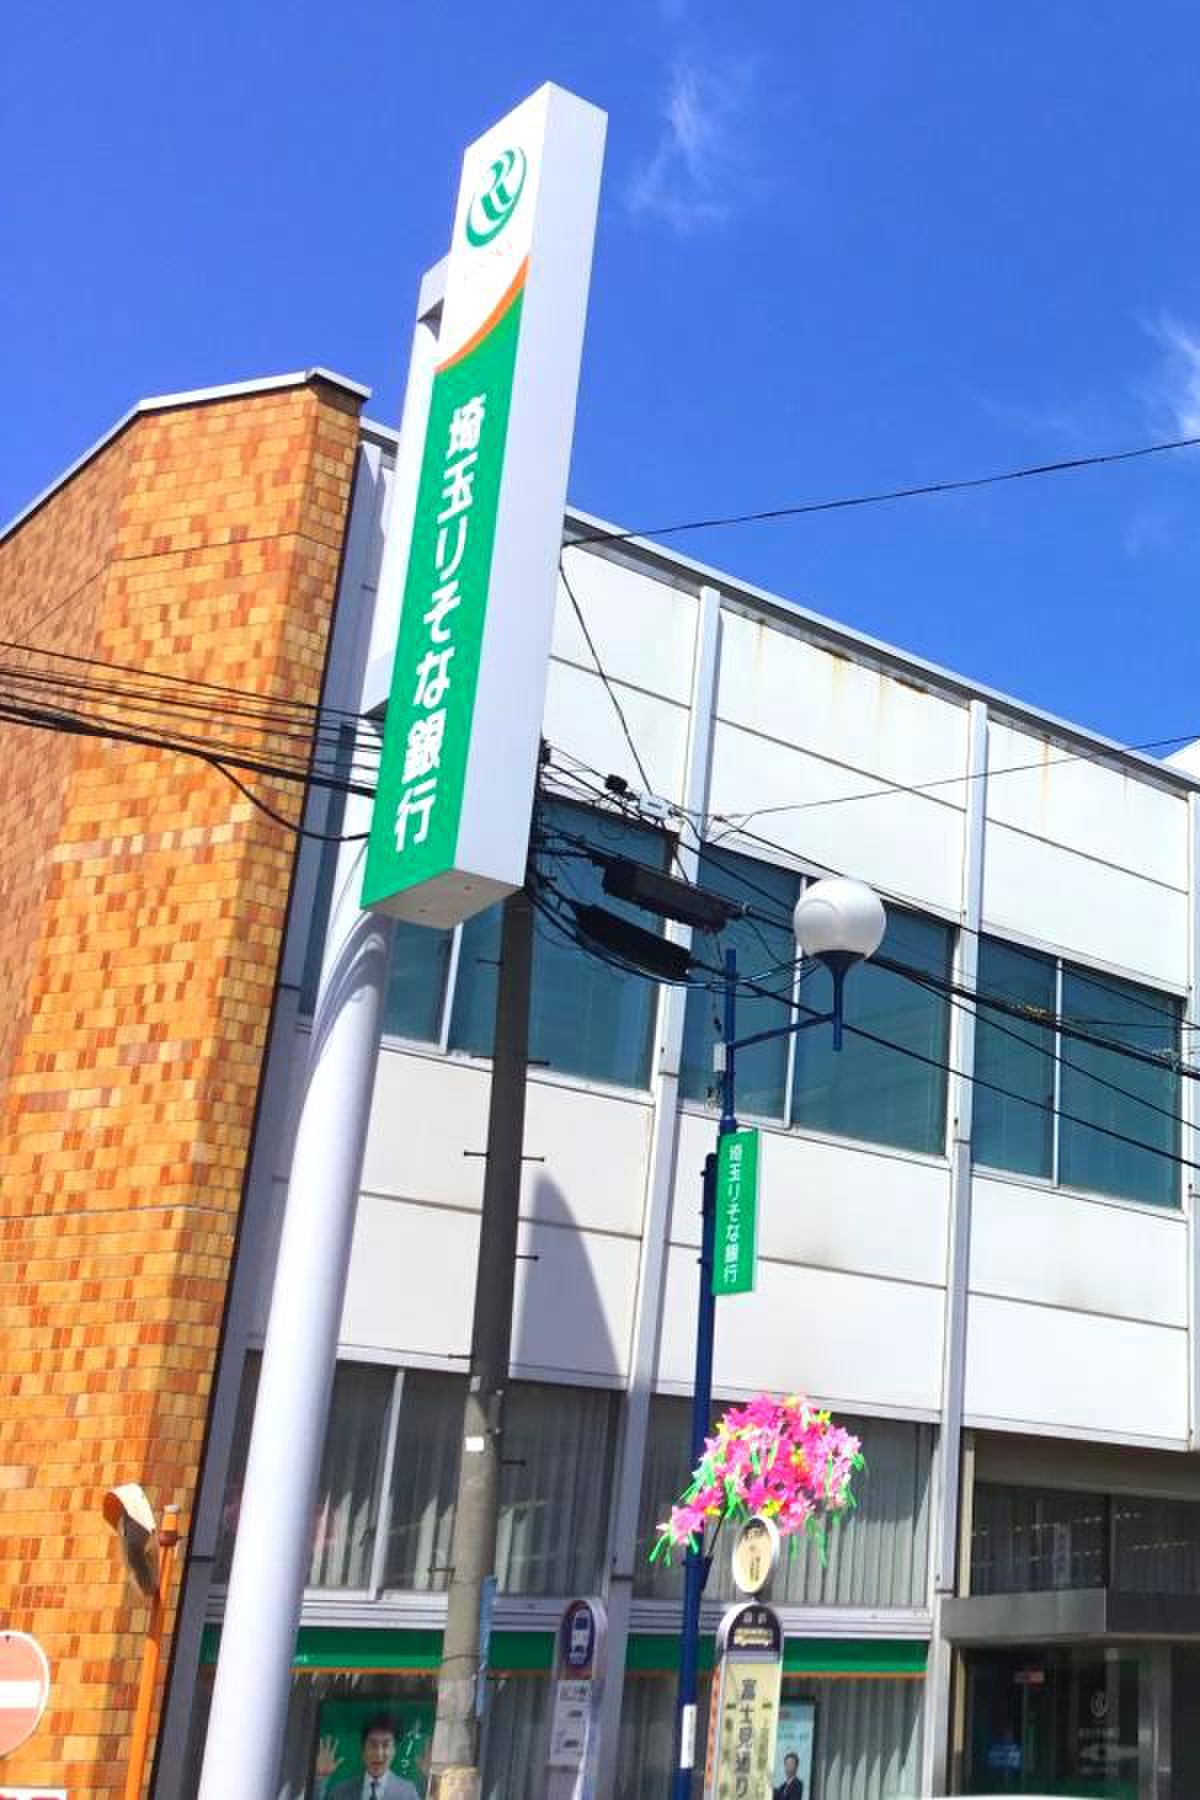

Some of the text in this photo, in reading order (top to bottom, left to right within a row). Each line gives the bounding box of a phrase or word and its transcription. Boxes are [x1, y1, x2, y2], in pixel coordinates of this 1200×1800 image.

[394, 394, 487, 853] 埼玉りそな銀行
[723, 1142, 743, 1284] 埼玉りそな銀行
